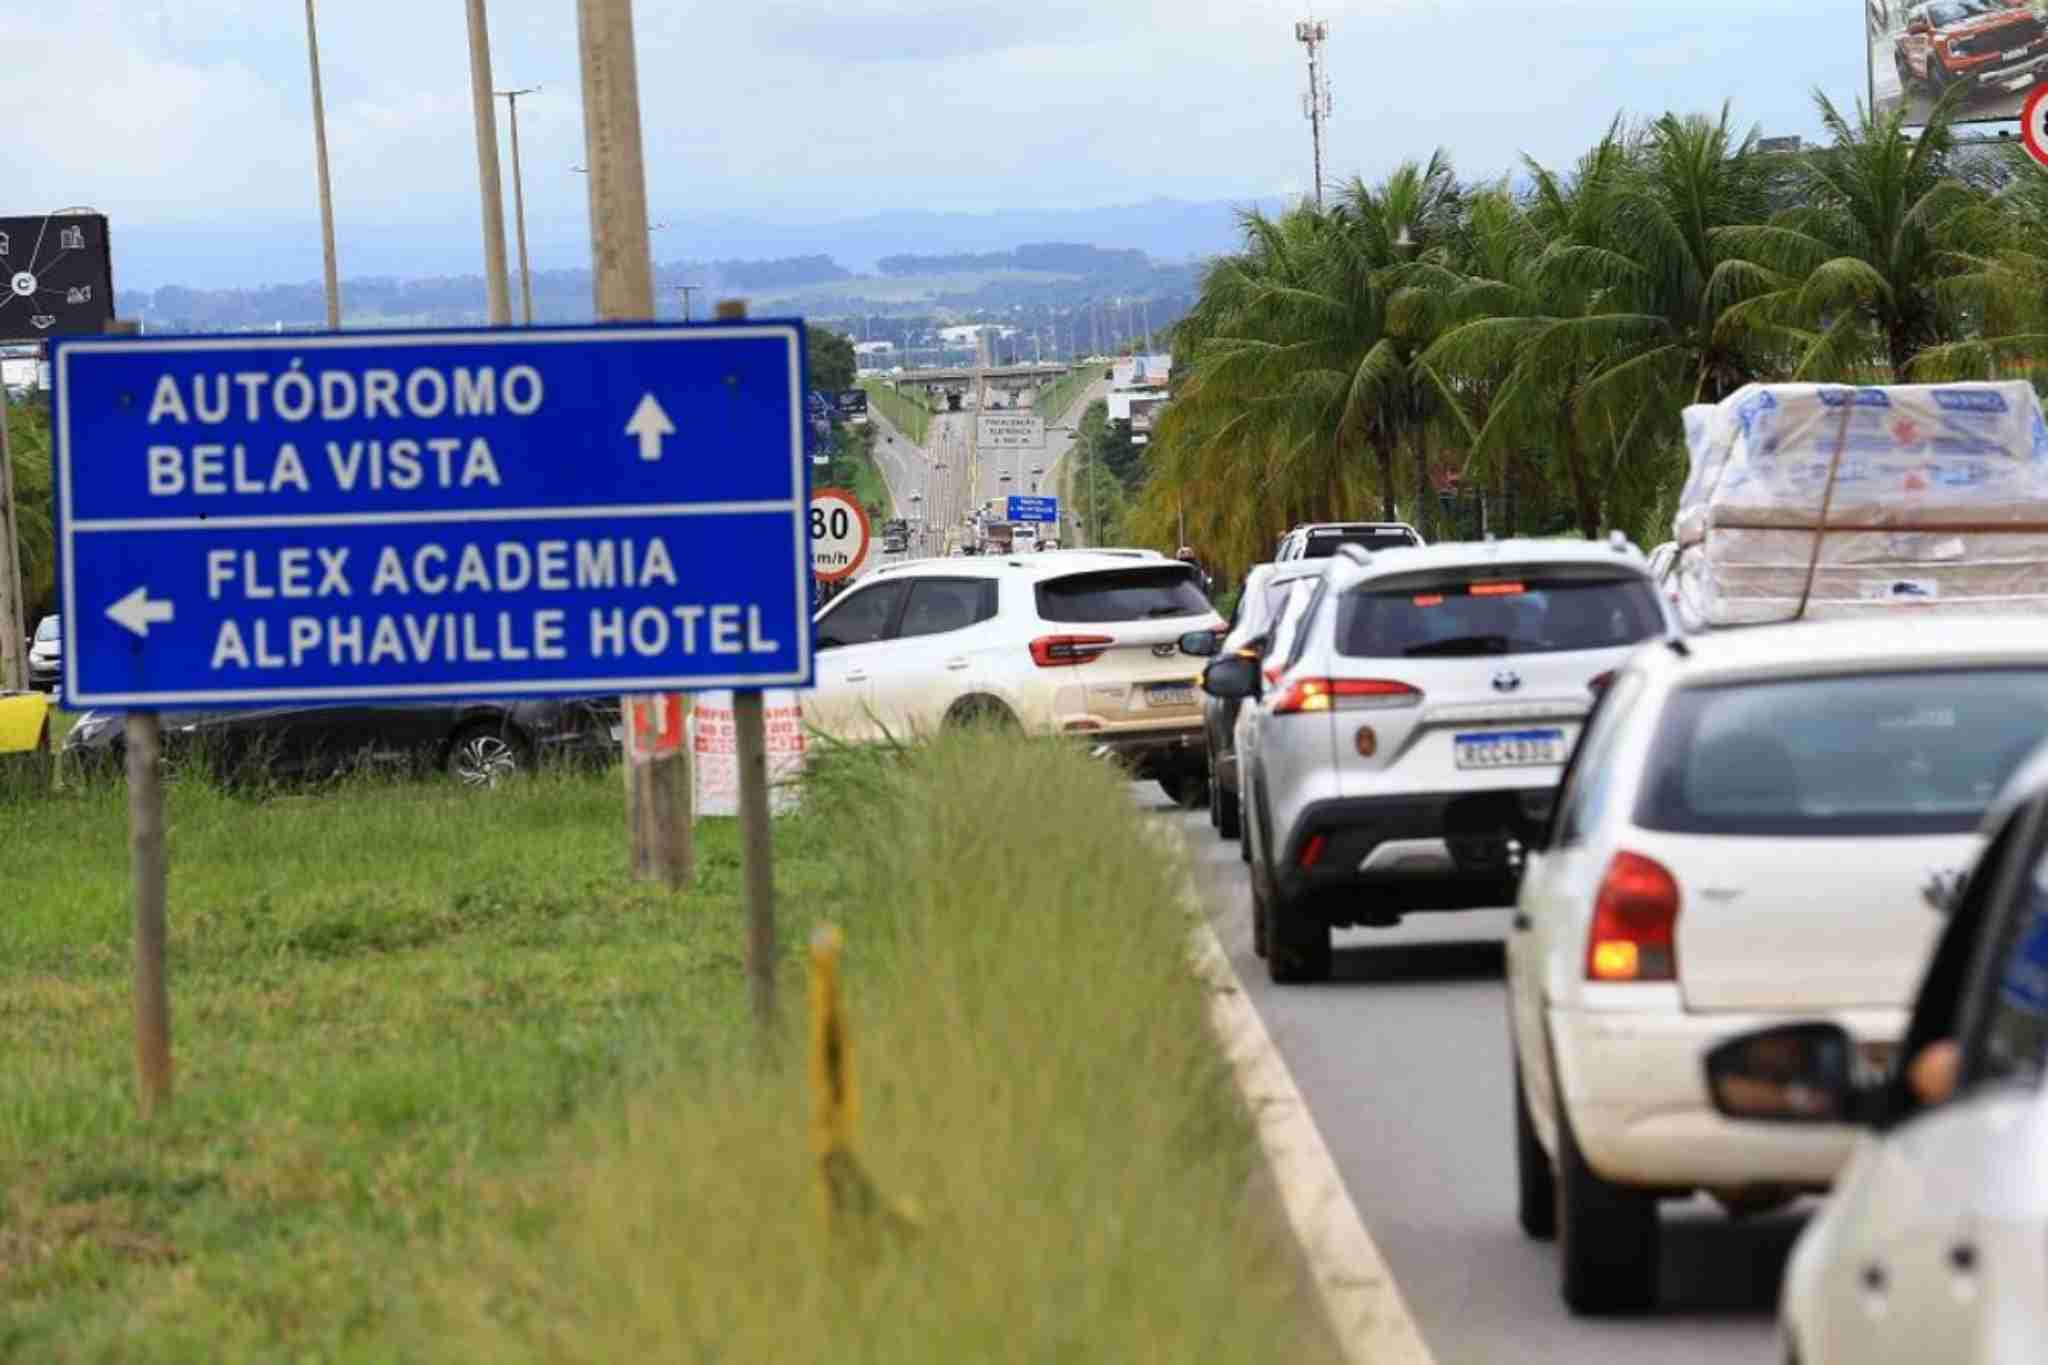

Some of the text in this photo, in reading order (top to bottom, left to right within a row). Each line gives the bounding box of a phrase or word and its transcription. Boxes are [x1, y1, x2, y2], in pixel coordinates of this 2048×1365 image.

[148, 358, 543, 424] AUTÓDROMO
[148, 438, 501, 495] BELA VISTA
[810, 508, 848, 540] 80
[207, 539, 677, 598] FLEX ACADEMIA
[211, 604, 779, 670] ALPHAVILLE HOTEL
